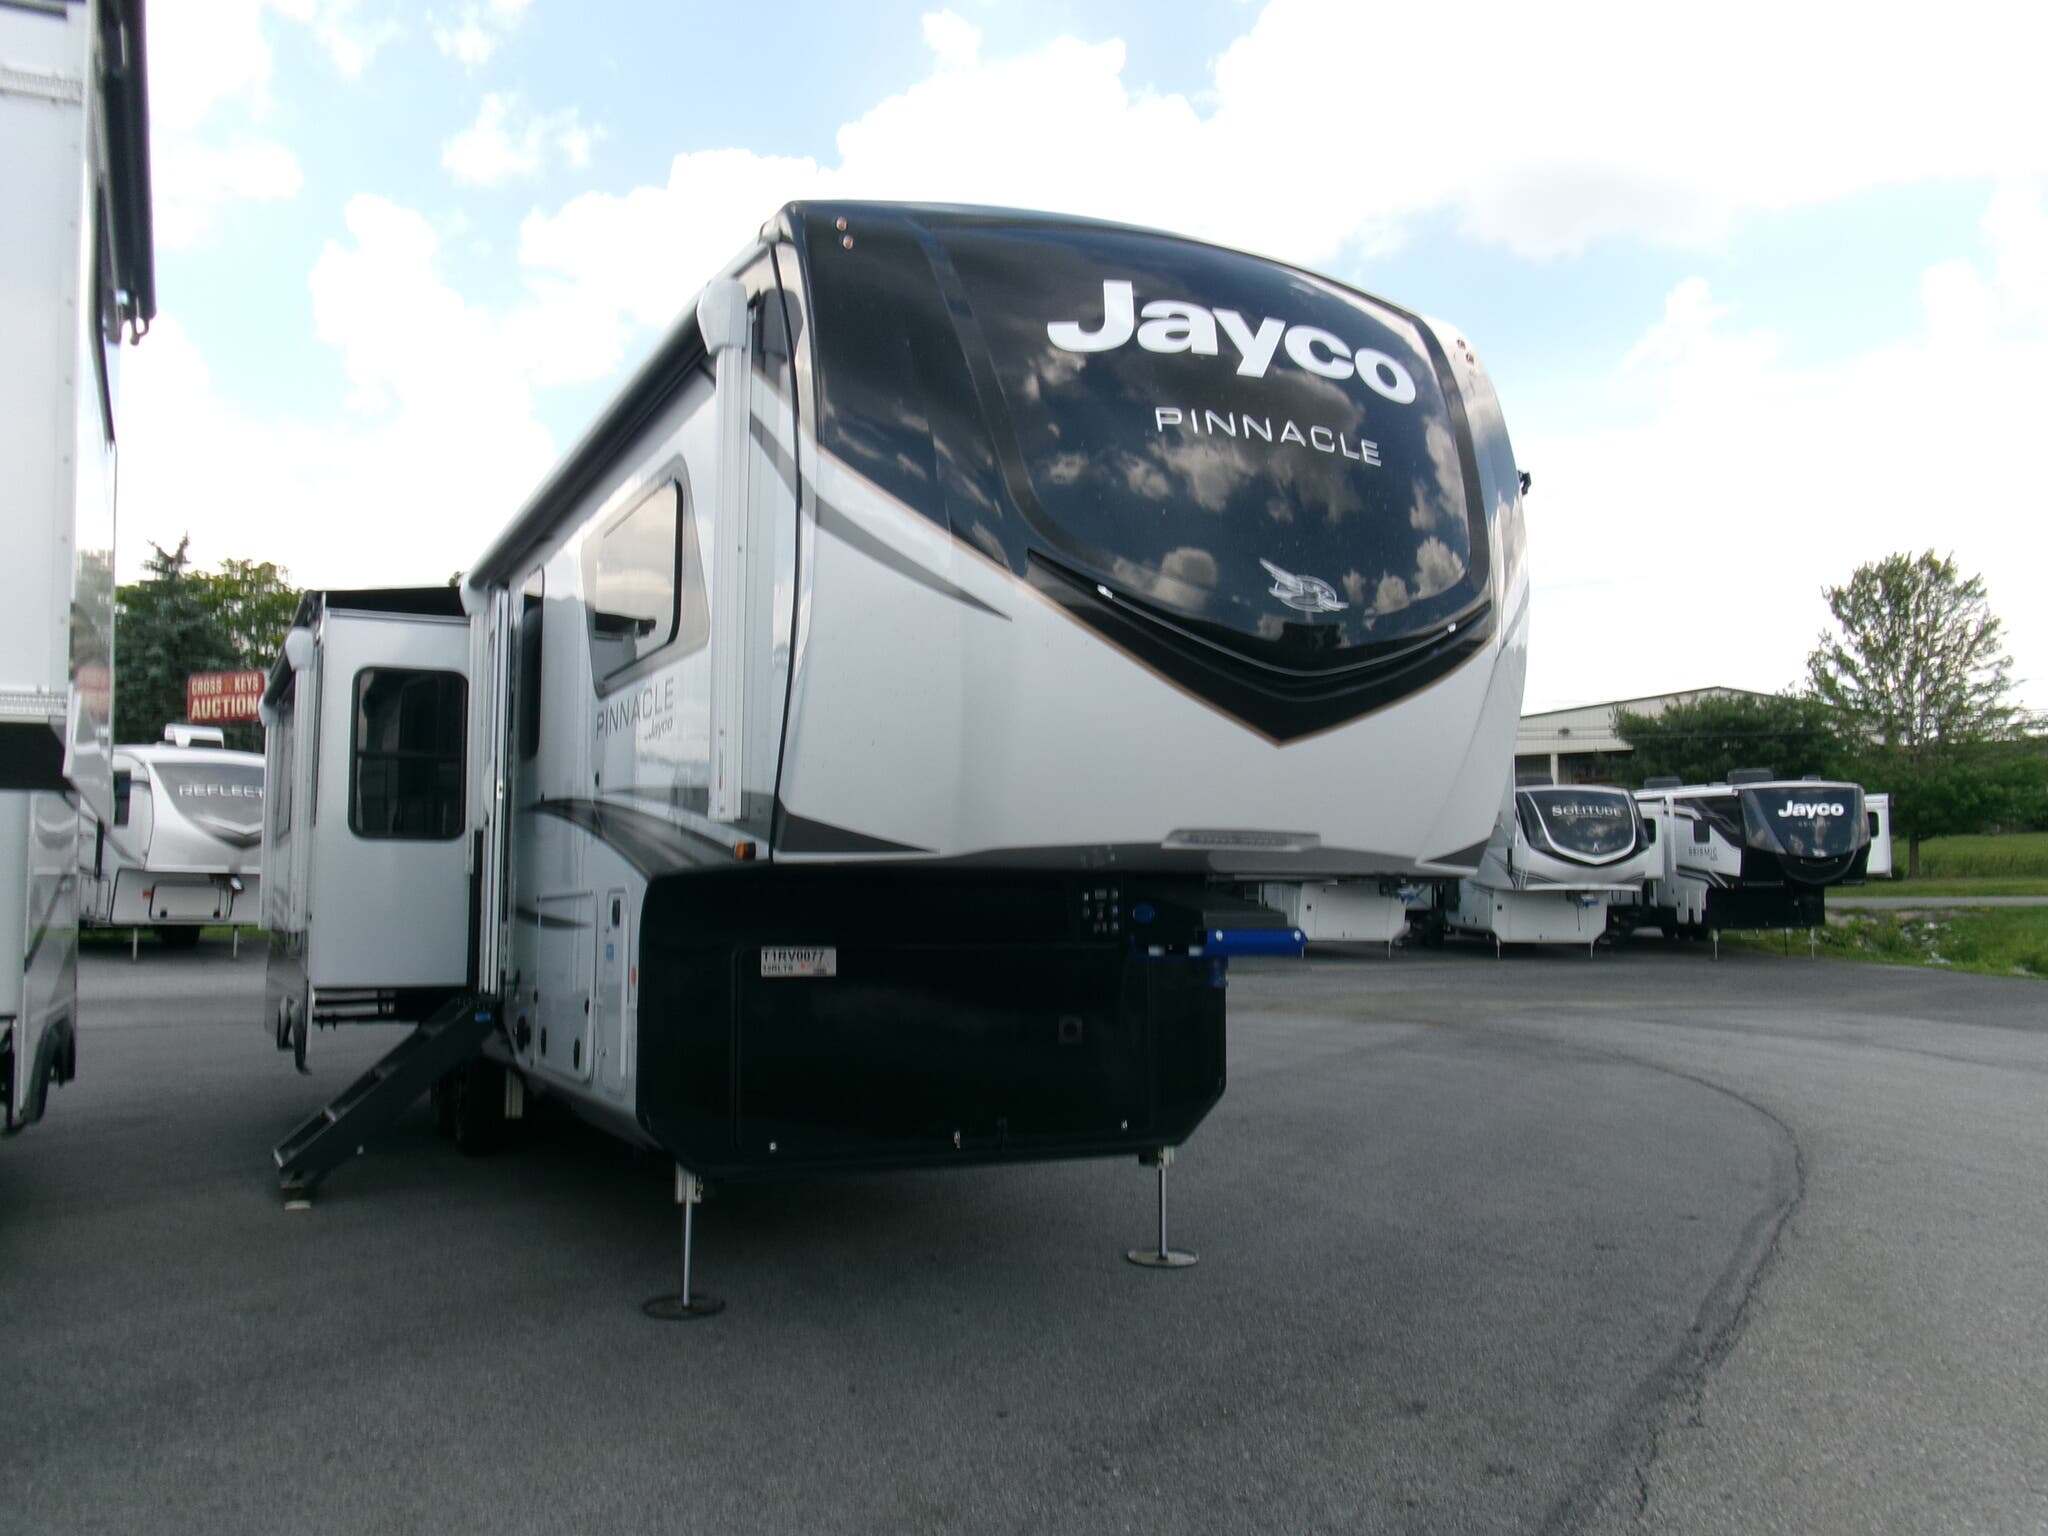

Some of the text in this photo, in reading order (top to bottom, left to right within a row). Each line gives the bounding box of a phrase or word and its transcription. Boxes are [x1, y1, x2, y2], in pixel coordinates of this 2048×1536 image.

[1047, 280, 1417, 405] Jayco
[1155, 406, 1382, 467] PINNACLE
[191, 672, 259, 697] CROSS KEYS
[596, 677, 674, 741] PINNACLE
[1778, 800, 1844, 818] Jayco
